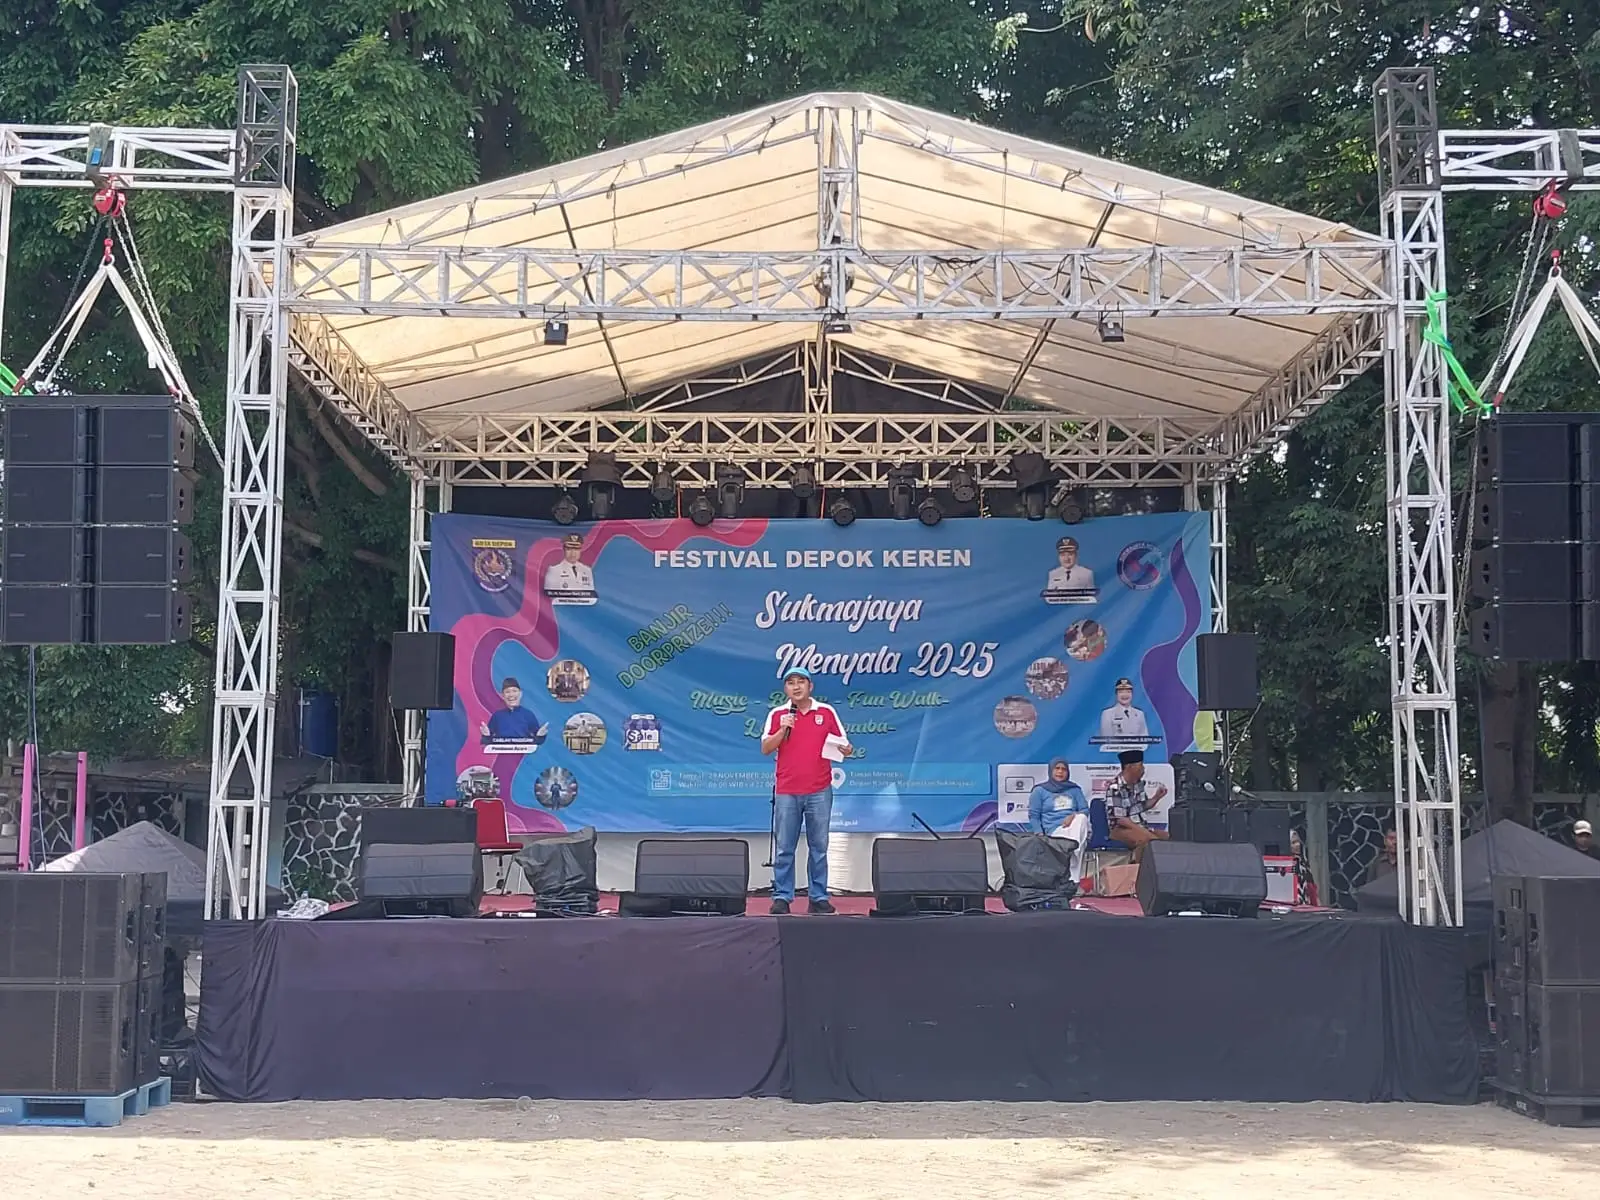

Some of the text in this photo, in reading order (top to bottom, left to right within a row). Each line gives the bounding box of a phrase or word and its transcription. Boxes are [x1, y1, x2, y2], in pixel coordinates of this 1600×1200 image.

[654, 549, 971, 568] FESTIVAL DEPOK KEREN
[627, 603, 694, 653] BANJIR
[756, 591, 923, 633] Sukmajaya
[617, 601, 734, 689] DOORPRIZE!!!
[775, 641, 999, 685] Menyala 2025
[690, 690, 748, 716] Music
[848, 691, 885, 709] Fun
[629, 730, 653, 741] Sale
